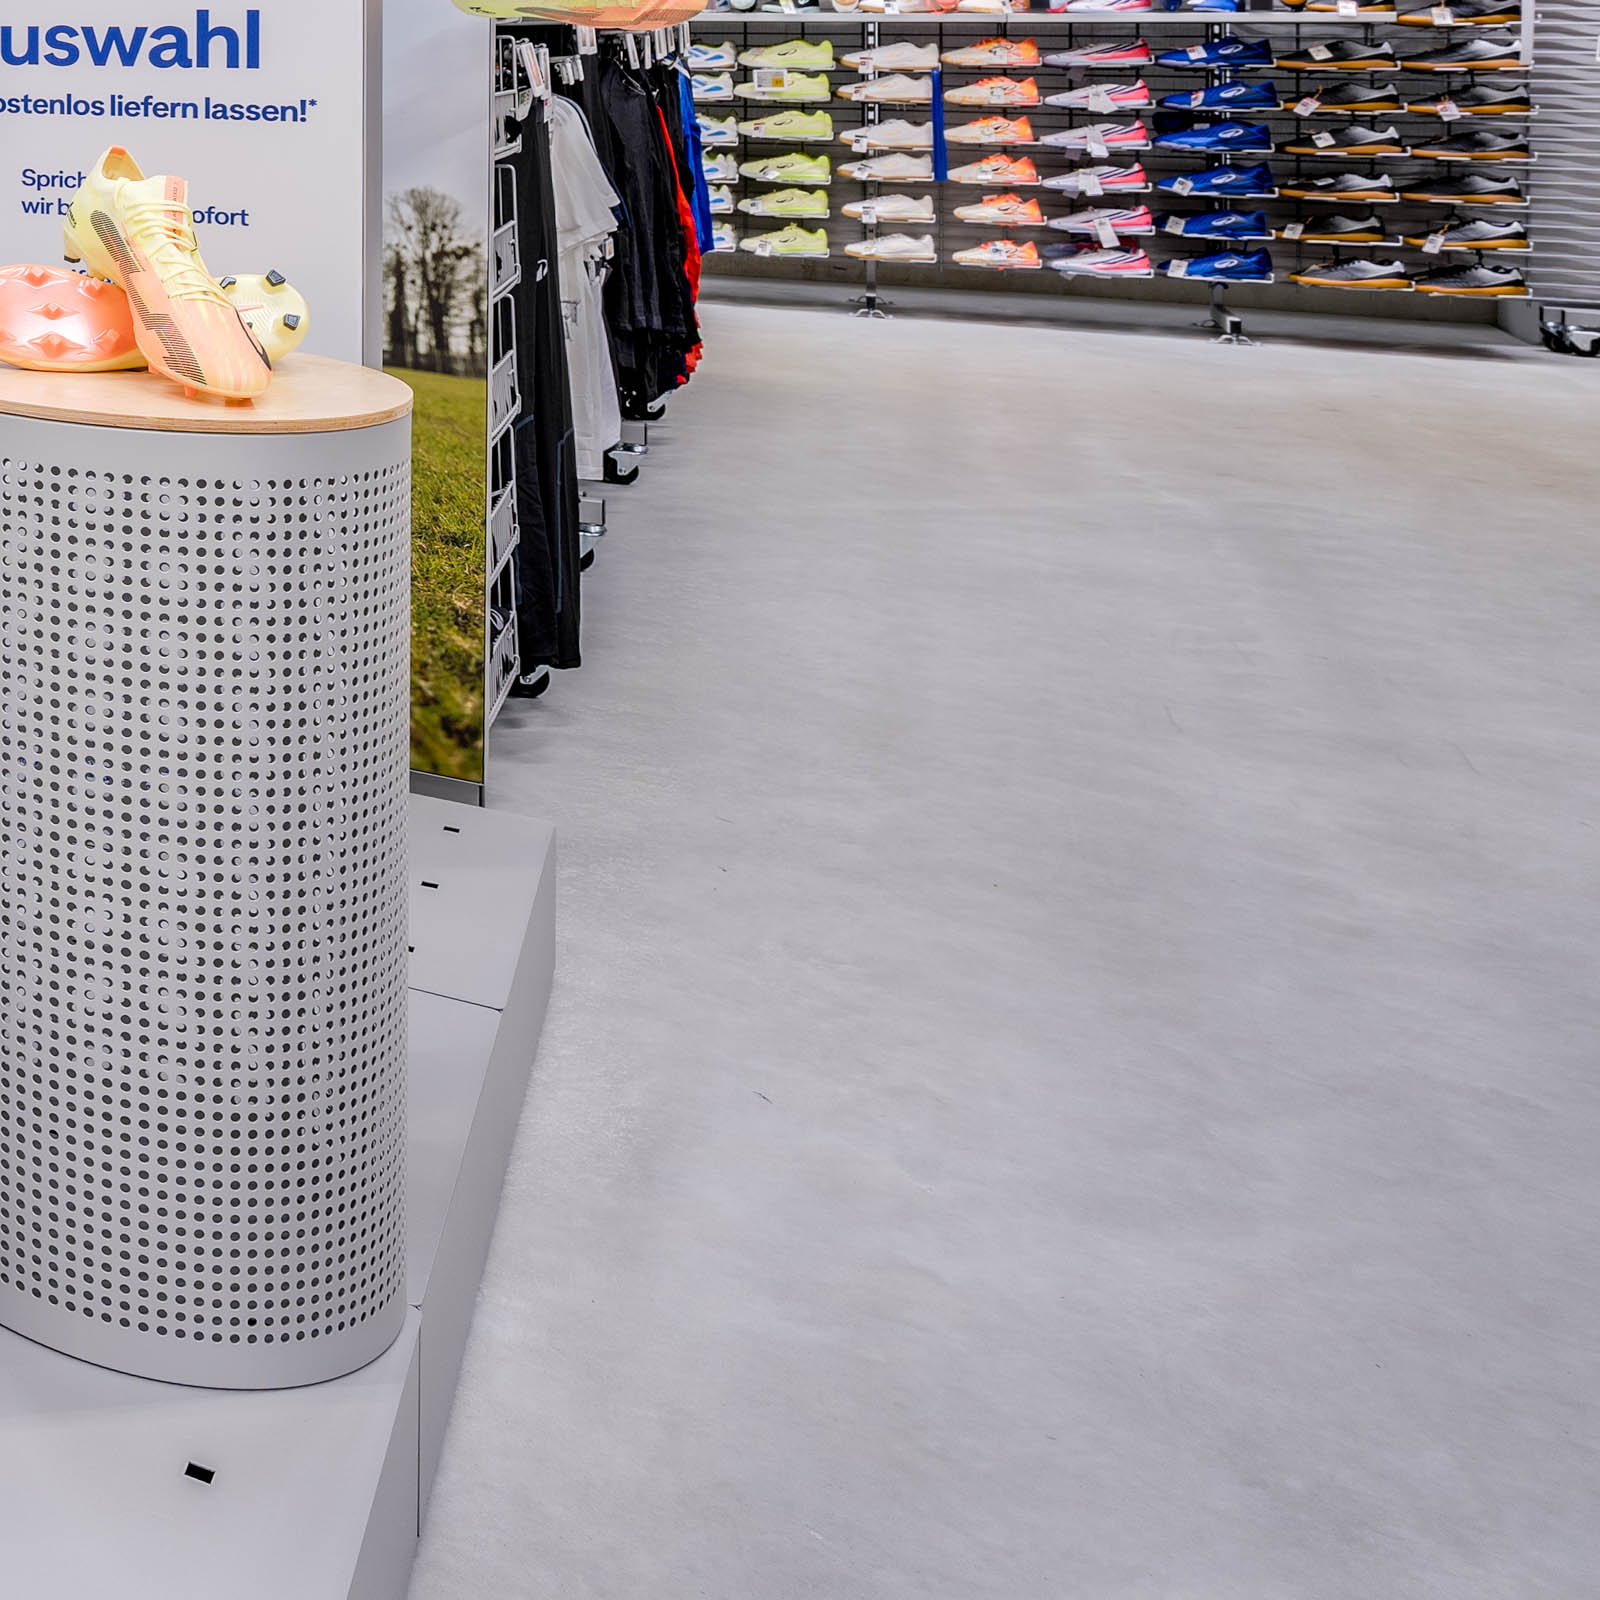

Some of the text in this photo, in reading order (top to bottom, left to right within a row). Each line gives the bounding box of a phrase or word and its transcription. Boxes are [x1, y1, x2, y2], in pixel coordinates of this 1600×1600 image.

[110, 94, 198, 119] liefern
[22, 198, 54, 216] wir
[191, 206, 250, 227] ofort
